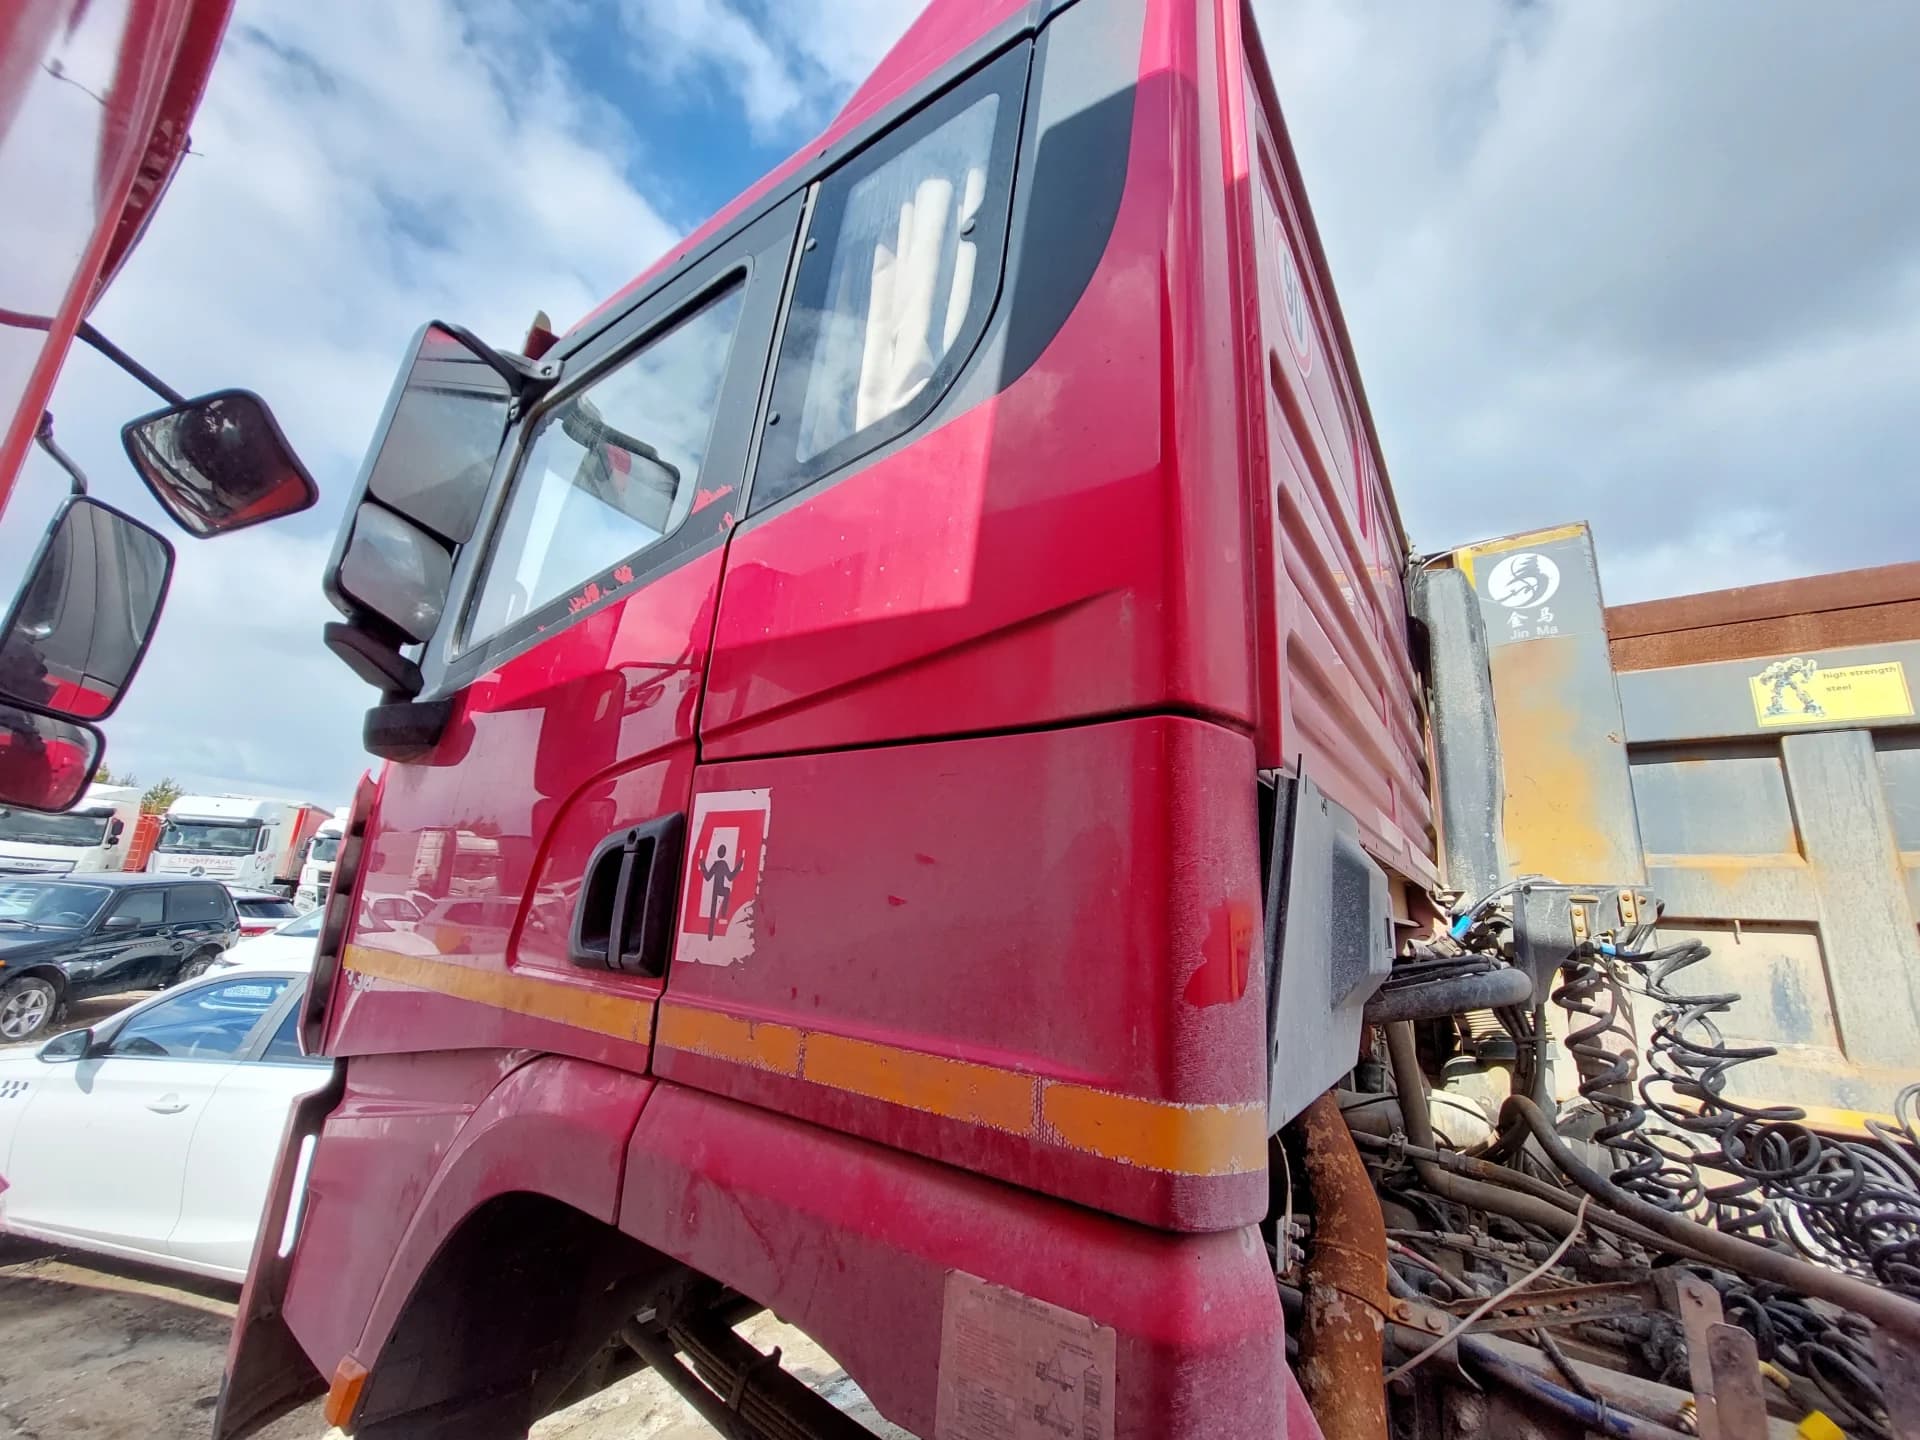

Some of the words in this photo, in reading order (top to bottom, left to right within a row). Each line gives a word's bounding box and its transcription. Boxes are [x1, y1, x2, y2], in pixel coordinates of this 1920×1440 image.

[1283, 253, 1304, 344] 90
[1507, 607, 1553, 628] 金马
[1510, 629, 1530, 641] Jin
[1536, 626, 1558, 635] Ma
[1823, 671, 1847, 680] high
[1850, 667, 1897, 676] strength
[1826, 684, 1852, 692] steel
